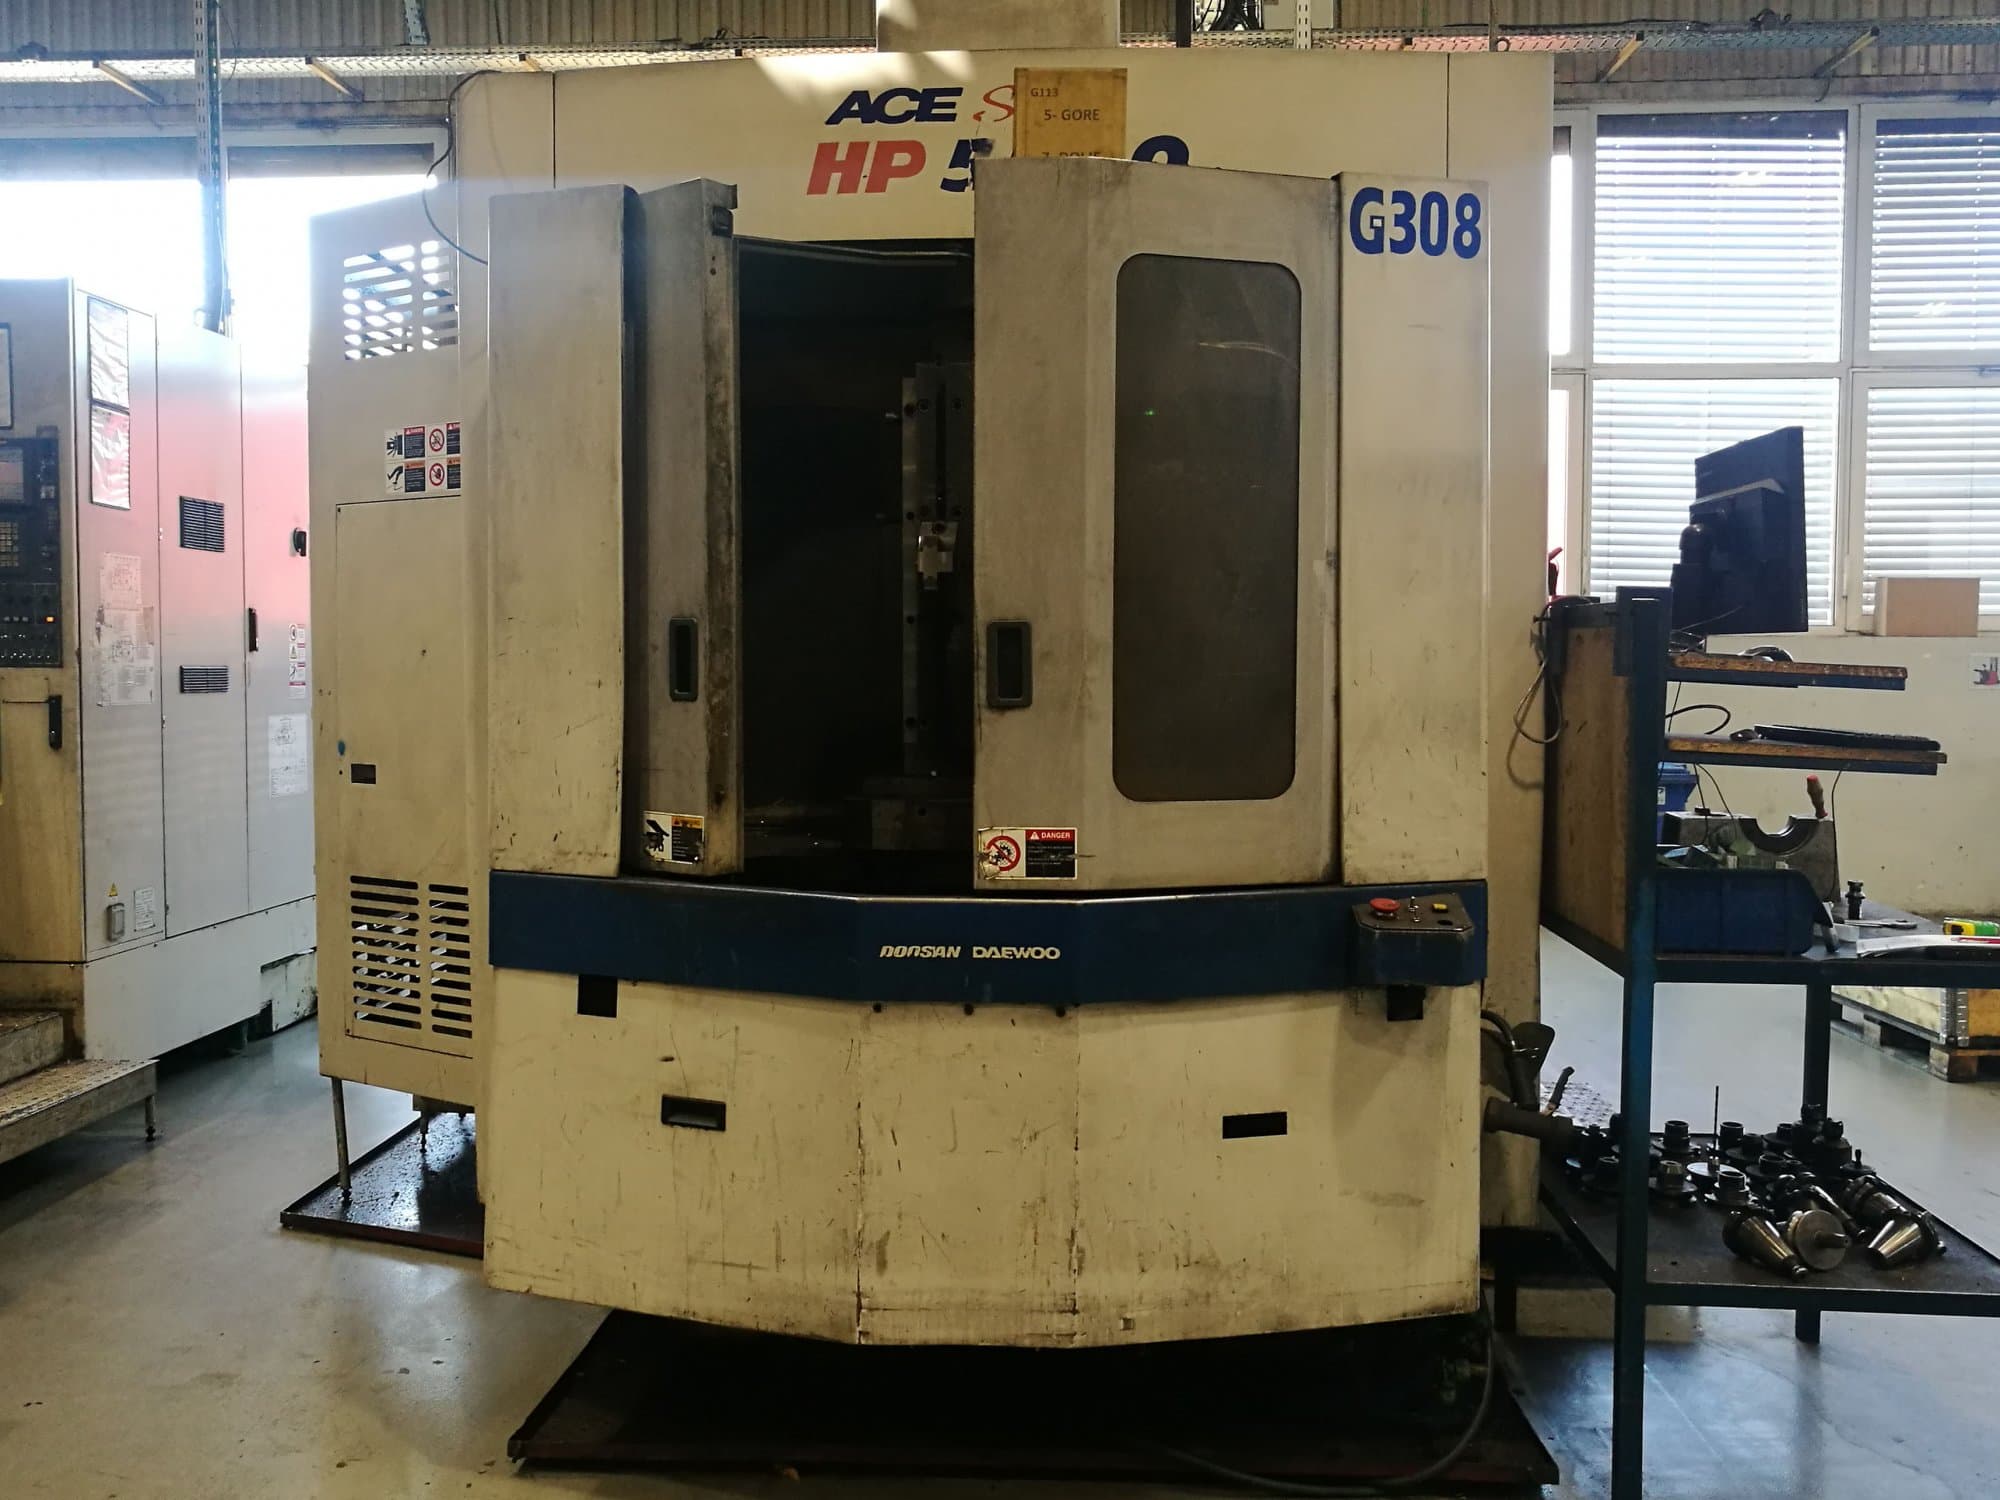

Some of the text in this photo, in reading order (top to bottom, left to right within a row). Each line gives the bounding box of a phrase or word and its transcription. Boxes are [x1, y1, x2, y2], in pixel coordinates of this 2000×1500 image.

[1031, 87, 1059, 97] G113
[825, 87, 963, 125] ACE
[1044, 109, 1101, 121] 5- GORE
[807, 140, 926, 195] HP
[1350, 186, 1482, 259] G308
[972, 946, 1061, 960] DAEWOO
